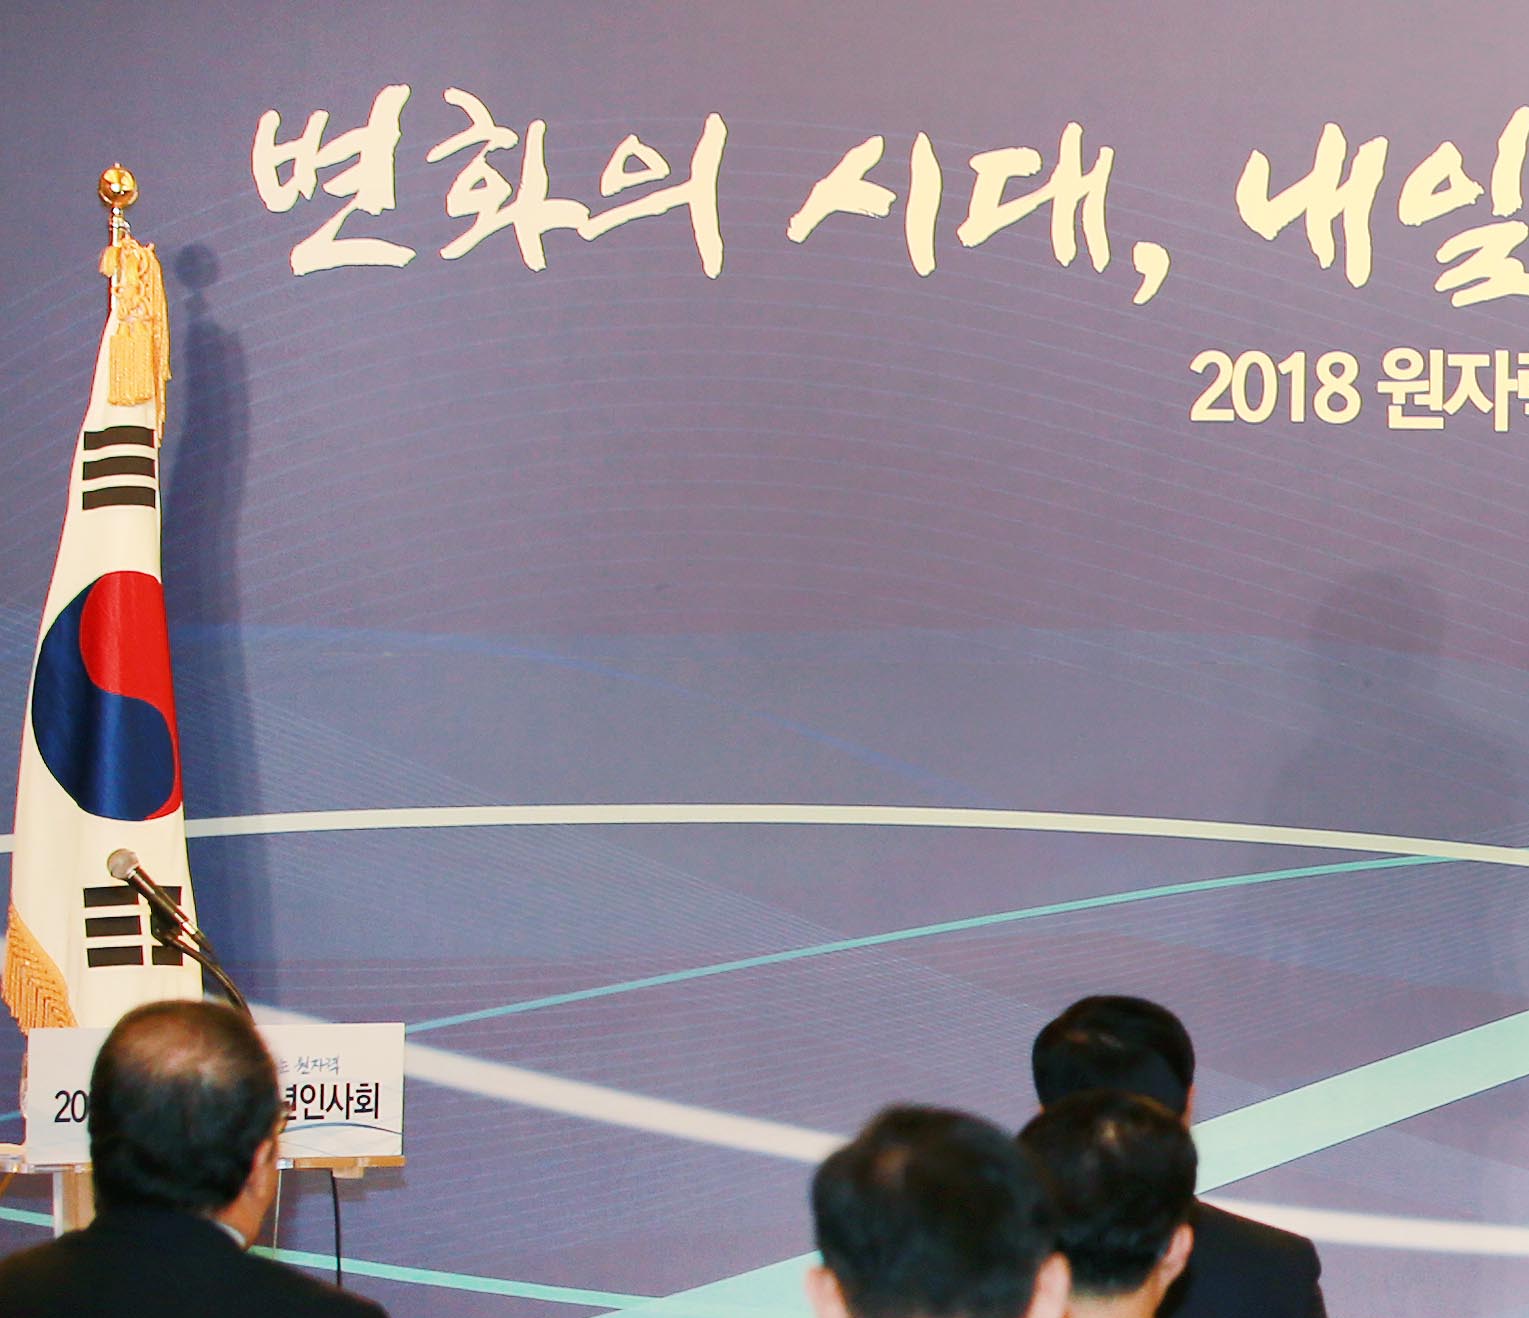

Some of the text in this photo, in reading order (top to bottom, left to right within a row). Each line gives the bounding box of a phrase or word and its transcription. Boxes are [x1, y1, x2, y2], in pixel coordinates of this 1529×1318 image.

[252, 84, 727, 279] 변화의
[787, 122, 1171, 304] 시대,
[1189, 350, 1362, 424] 2018
[54, 1082, 379, 1123] 20 년인사회
